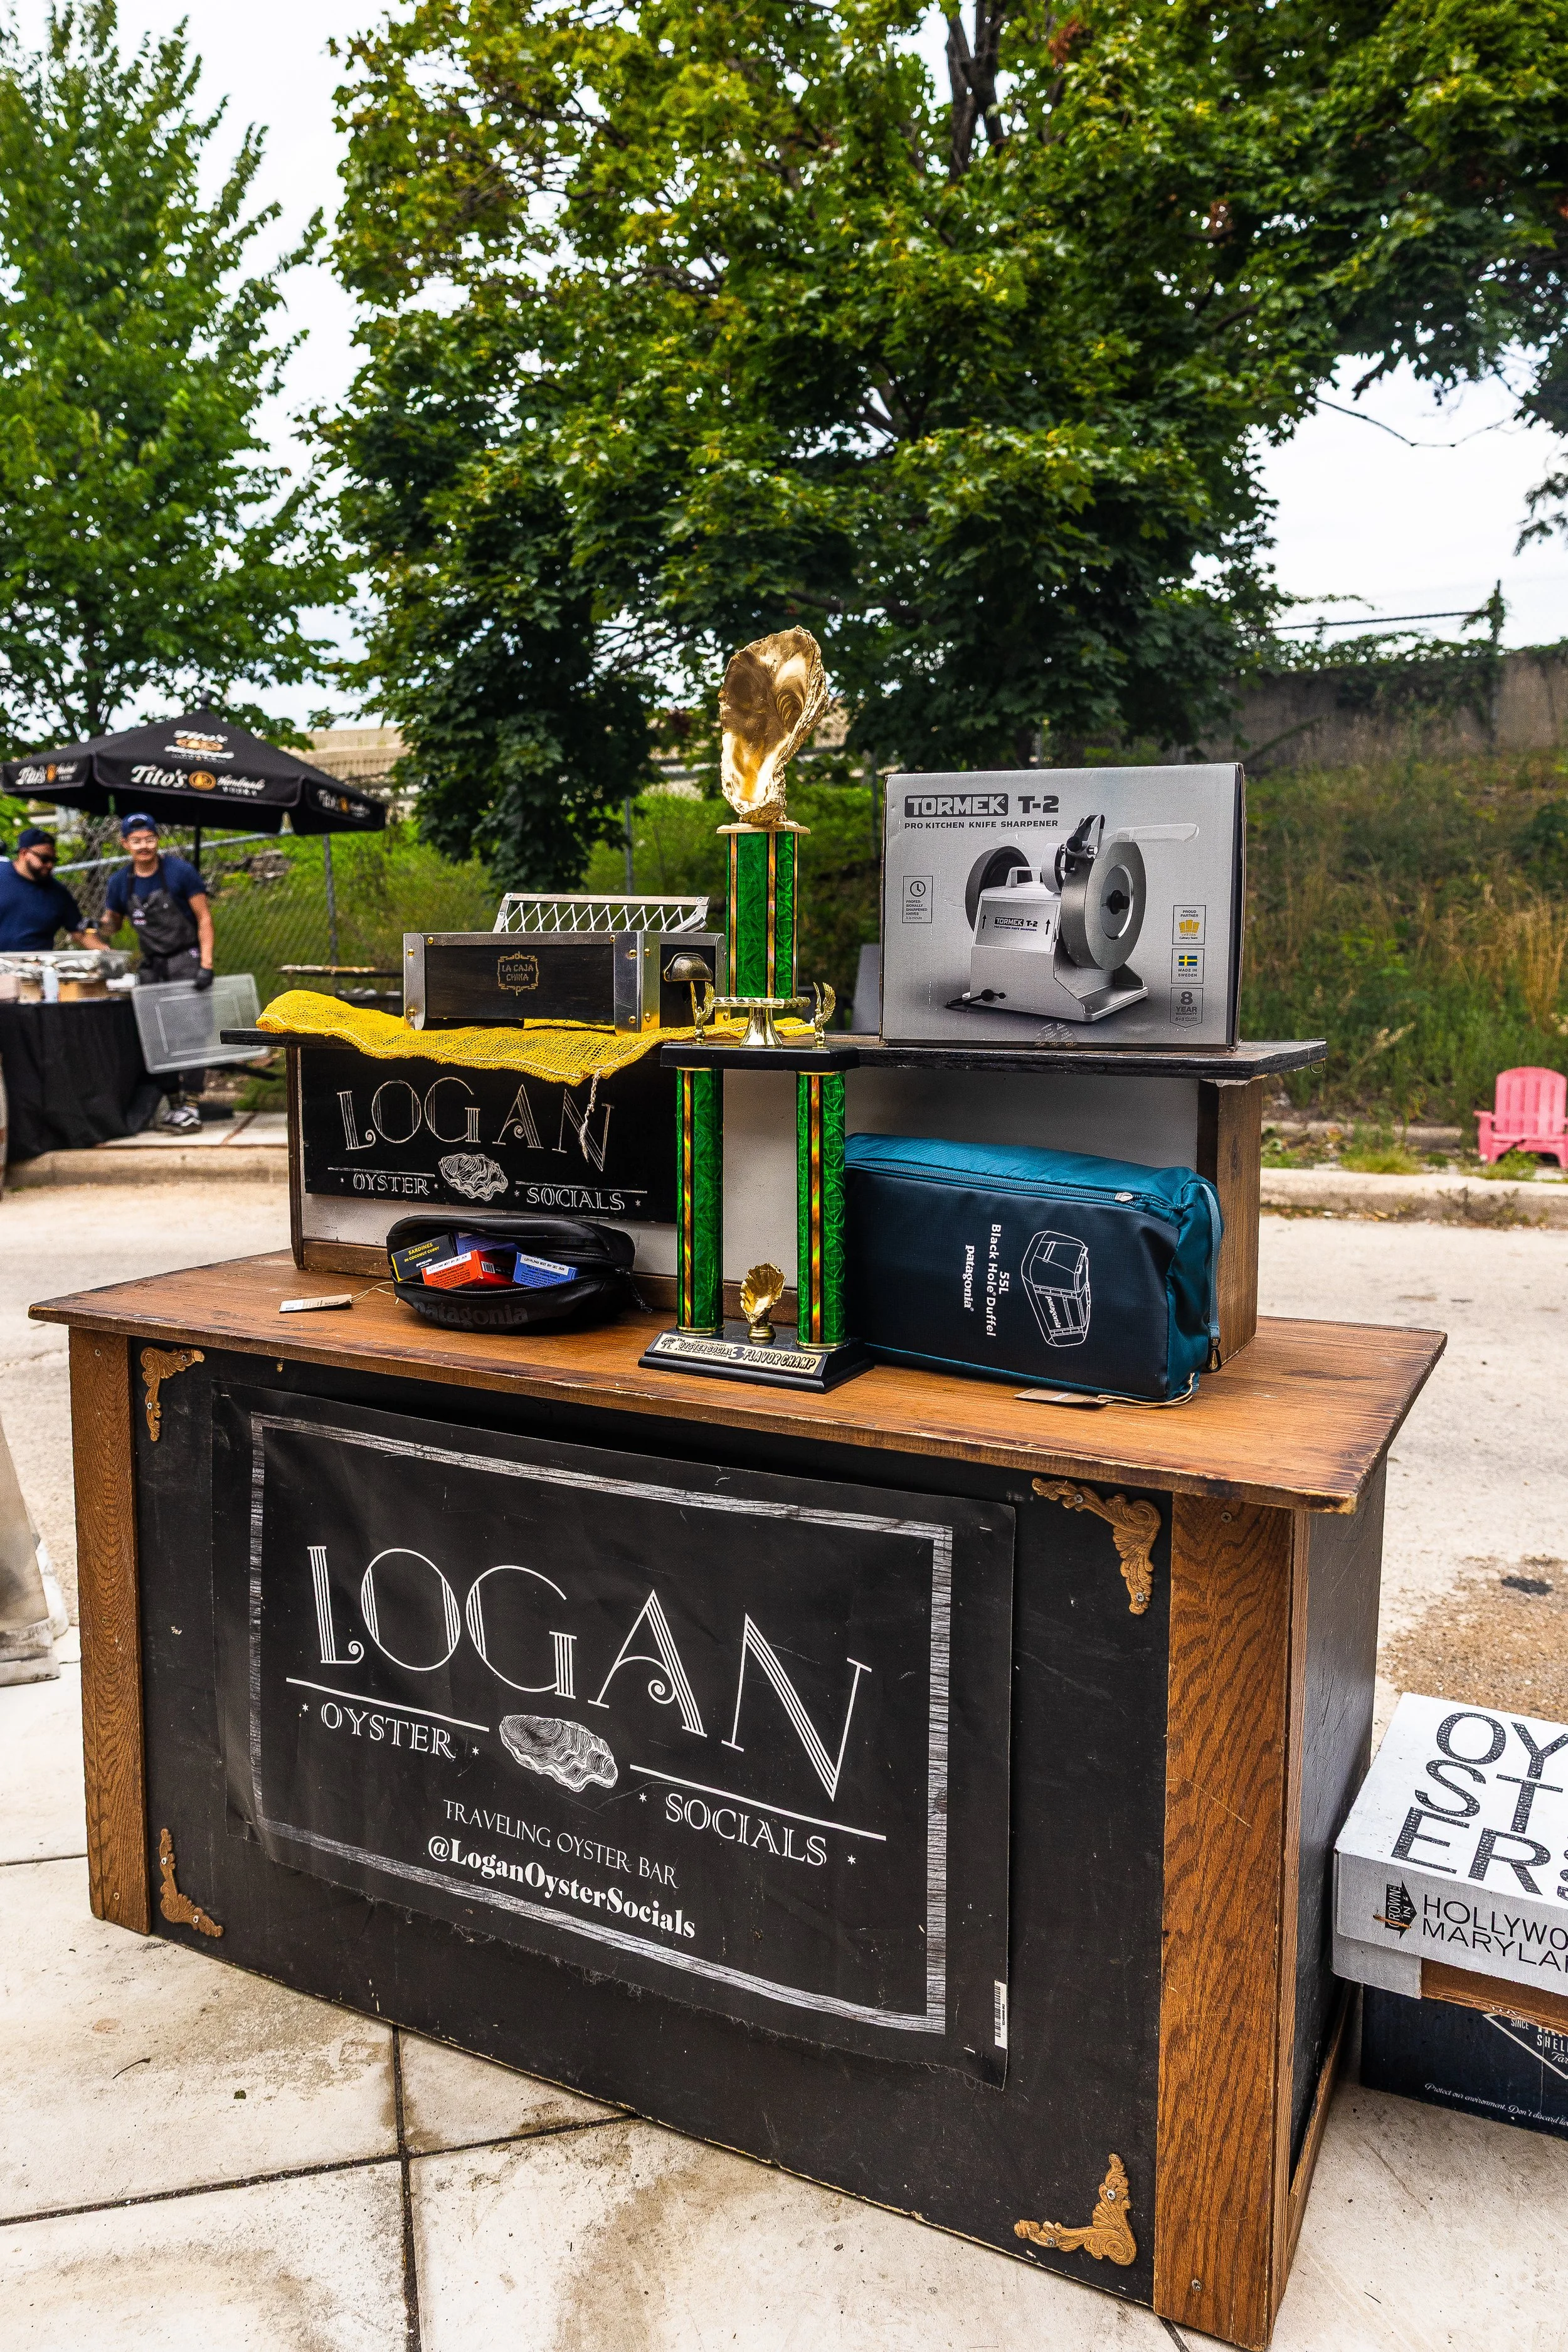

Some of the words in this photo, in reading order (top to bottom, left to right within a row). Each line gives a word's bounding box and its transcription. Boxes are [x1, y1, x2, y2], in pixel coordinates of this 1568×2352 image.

[131, 764, 188, 788] Tito's
[908, 796, 1005, 815] TORMEK
[1017, 795, 1060, 814] T-2
[1000, 820, 1058, 828] SHARPENER
[996, 918, 1023, 926] TORMEK
[506, 973, 529, 982] CHINA
[514, 963, 534, 972] CAJA
[1180, 991, 1193, 1005] 8
[337, 1077, 615, 1172] LOGAN
[352, 1173, 430, 1195] OYSTER
[526, 1187, 625, 1210] SOCIALS
[408, 1242, 433, 1255] SARDINES
[409, 1251, 426, 1261] COCONUT
[427, 1246, 440, 1254] CURRY
[989, 1224, 1002, 1259] Black
[999, 1271, 1010, 1295] 55L
[986, 1297, 996, 1337] Duffel
[1045, 1295, 1061, 1328] patagonia
[679, 1341, 707, 1352] OYSTER
[706, 1345, 733, 1355] SOCIAL
[728, 1347, 745, 1360] 3
[743, 1348, 781, 1365] FLAVOR
[780, 1354, 816, 1370] CHAMP
[307, 1546, 872, 1801] LOGAN
[320, 1702, 457, 1759] OYSTER
[1436, 1712, 1568, 1780] OY
[1415, 1760, 1563, 1834] ST
[665, 1793, 828, 1867] SOCIALS
[443, 1799, 552, 1848] TRAVELING
[557, 1831, 632, 1873] OYSTER
[638, 1858, 679, 1889] BAR
[427, 1835, 697, 1939] @LoganOysterSocials
[1403, 1906, 1411, 1917] IN
[1422, 1917, 1568, 1973] MARYLA
[1511, 2018, 1529, 2030] SINCE
[1424, 2082, 1452, 2096] Protect
[1465, 2095, 1507, 2111] environment.
[1508, 2104, 1532, 2117] Don't
[1532, 2112, 1559, 2124] discard
